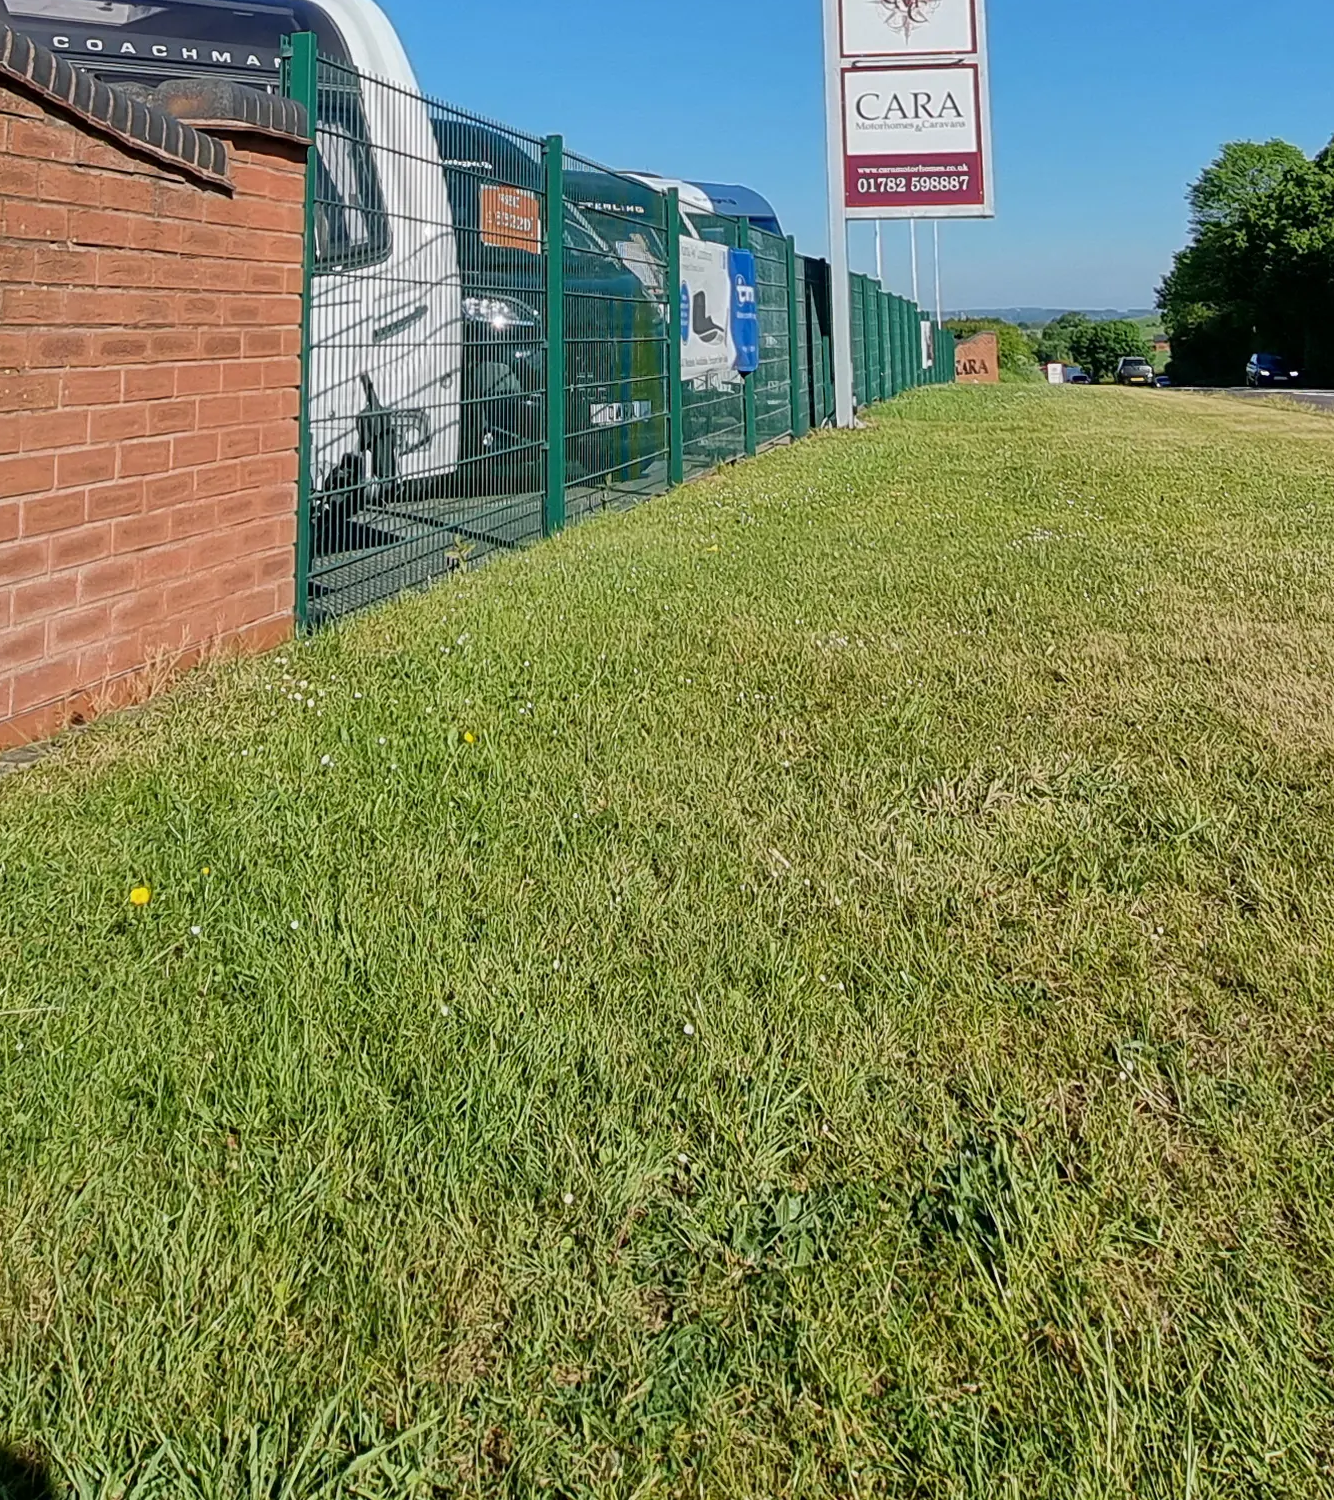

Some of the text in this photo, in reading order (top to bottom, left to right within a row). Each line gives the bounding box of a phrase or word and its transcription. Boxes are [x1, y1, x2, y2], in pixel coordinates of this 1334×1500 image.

[855, 91, 964, 121] CARA
[855, 120, 966, 132] Motorhomes & Caravans
[857, 176, 969, 193] 01782 598887
